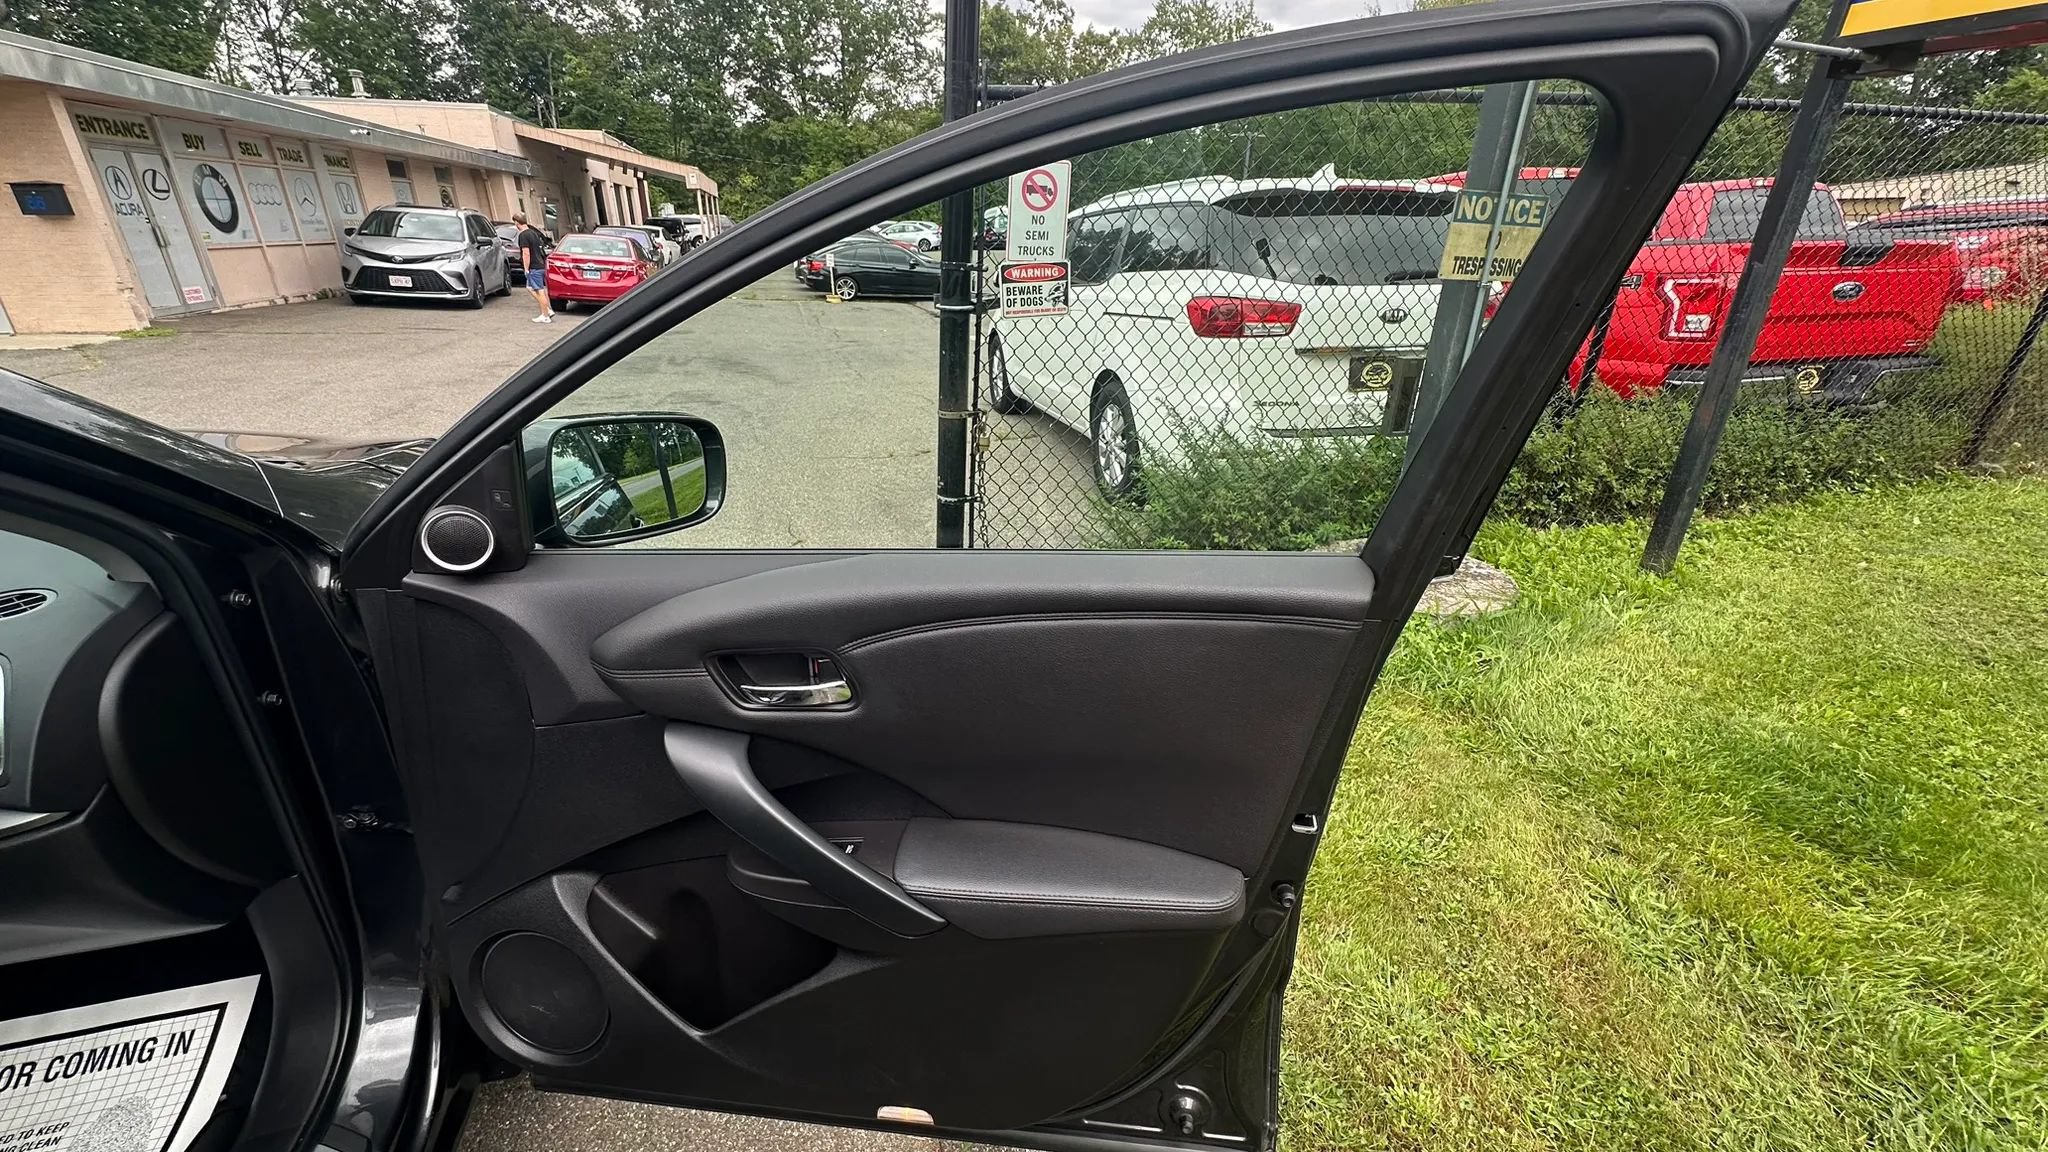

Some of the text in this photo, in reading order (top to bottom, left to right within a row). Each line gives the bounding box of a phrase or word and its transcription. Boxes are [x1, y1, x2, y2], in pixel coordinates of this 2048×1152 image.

[75, 114, 149, 140] ENTRANCE
[181, 132, 206, 150] BUY
[238, 141, 263, 158] SELL
[276, 147, 304, 163] TRADE
[115, 202, 144, 216] ACURA
[1457, 194, 1544, 224] NOICE
[1031, 215, 1045, 226] NO
[1025, 231, 1049, 241] SEMI
[1018, 245, 1055, 256] TRUCKS
[1011, 267, 1059, 279] WARNING
[1452, 256, 1523, 277] TRESPSSING
[1006, 285, 1043, 297] BEWARE
[1006, 297, 1044, 308] OF DOGS
[1385, 309, 1405, 323] KIA
[43, 1037, 158, 1083] COMING
[164, 1029, 196, 1059] IN
[17, 1129, 35, 1142] TO
[36, 1121, 70, 1137] KEEP
[18, 1135, 63, 1152] CLEAN
